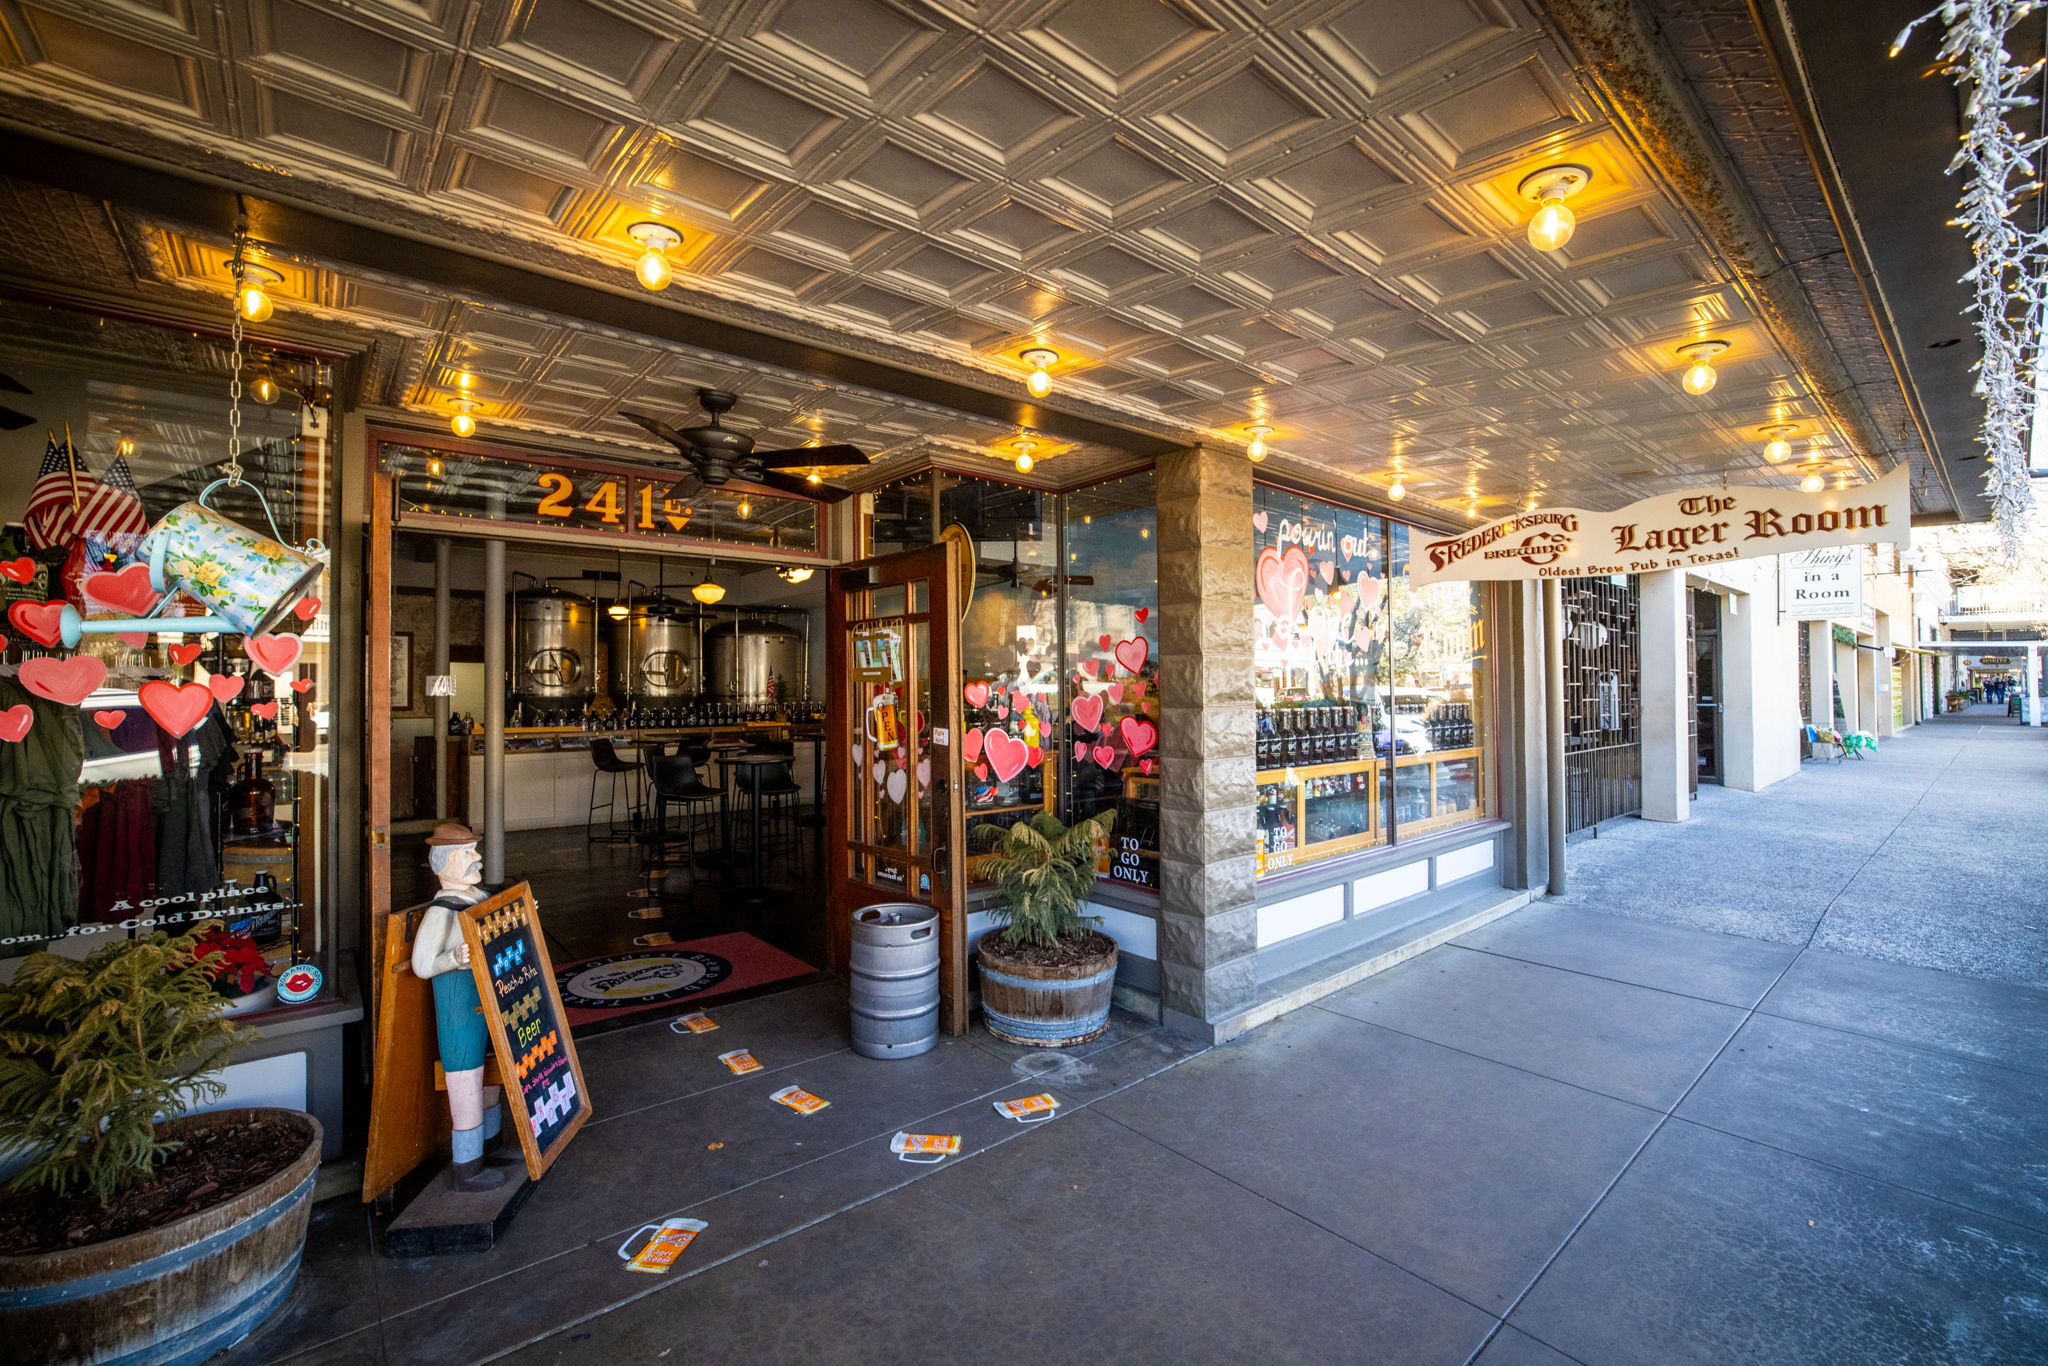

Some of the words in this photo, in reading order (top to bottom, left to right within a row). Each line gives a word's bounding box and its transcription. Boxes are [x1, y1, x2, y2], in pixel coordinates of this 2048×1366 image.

[1677, 495, 1737, 516] The
[1611, 521, 1731, 554] Lager
[1744, 503, 1889, 541] Room
[1425, 513, 1579, 573] FREDERICKSBURG
[1539, 567, 1581, 577] Oldest
[1588, 565, 1624, 574] Brew
[1630, 561, 1659, 571] Pub
[1666, 558, 1681, 567] in
[1688, 546, 1740, 564] Texas!
[1804, 571, 1821, 582] in
[1831, 572, 1840, 581] a
[1795, 588, 1850, 599] Room
[877, 702, 895, 742] OPEN
[1273, 826, 1288, 839] TO
[1121, 837, 1139, 850] TO
[1273, 841, 1288, 853] GO
[1121, 852, 1140, 866] GO
[1267, 854, 1294, 870] ONLY
[1113, 865, 1149, 883] ONLY
[109, 901, 134, 912] A
[139, 892, 197, 909] cool
[201, 885, 268, 903] place
[118, 912, 185, 930] Cold
[189, 901, 304, 922] Drinks...
[494, 941, 525, 977] FROZEN
[279, 965, 314, 987] ROMANTIC
[517, 1019, 541, 1048] Beer
